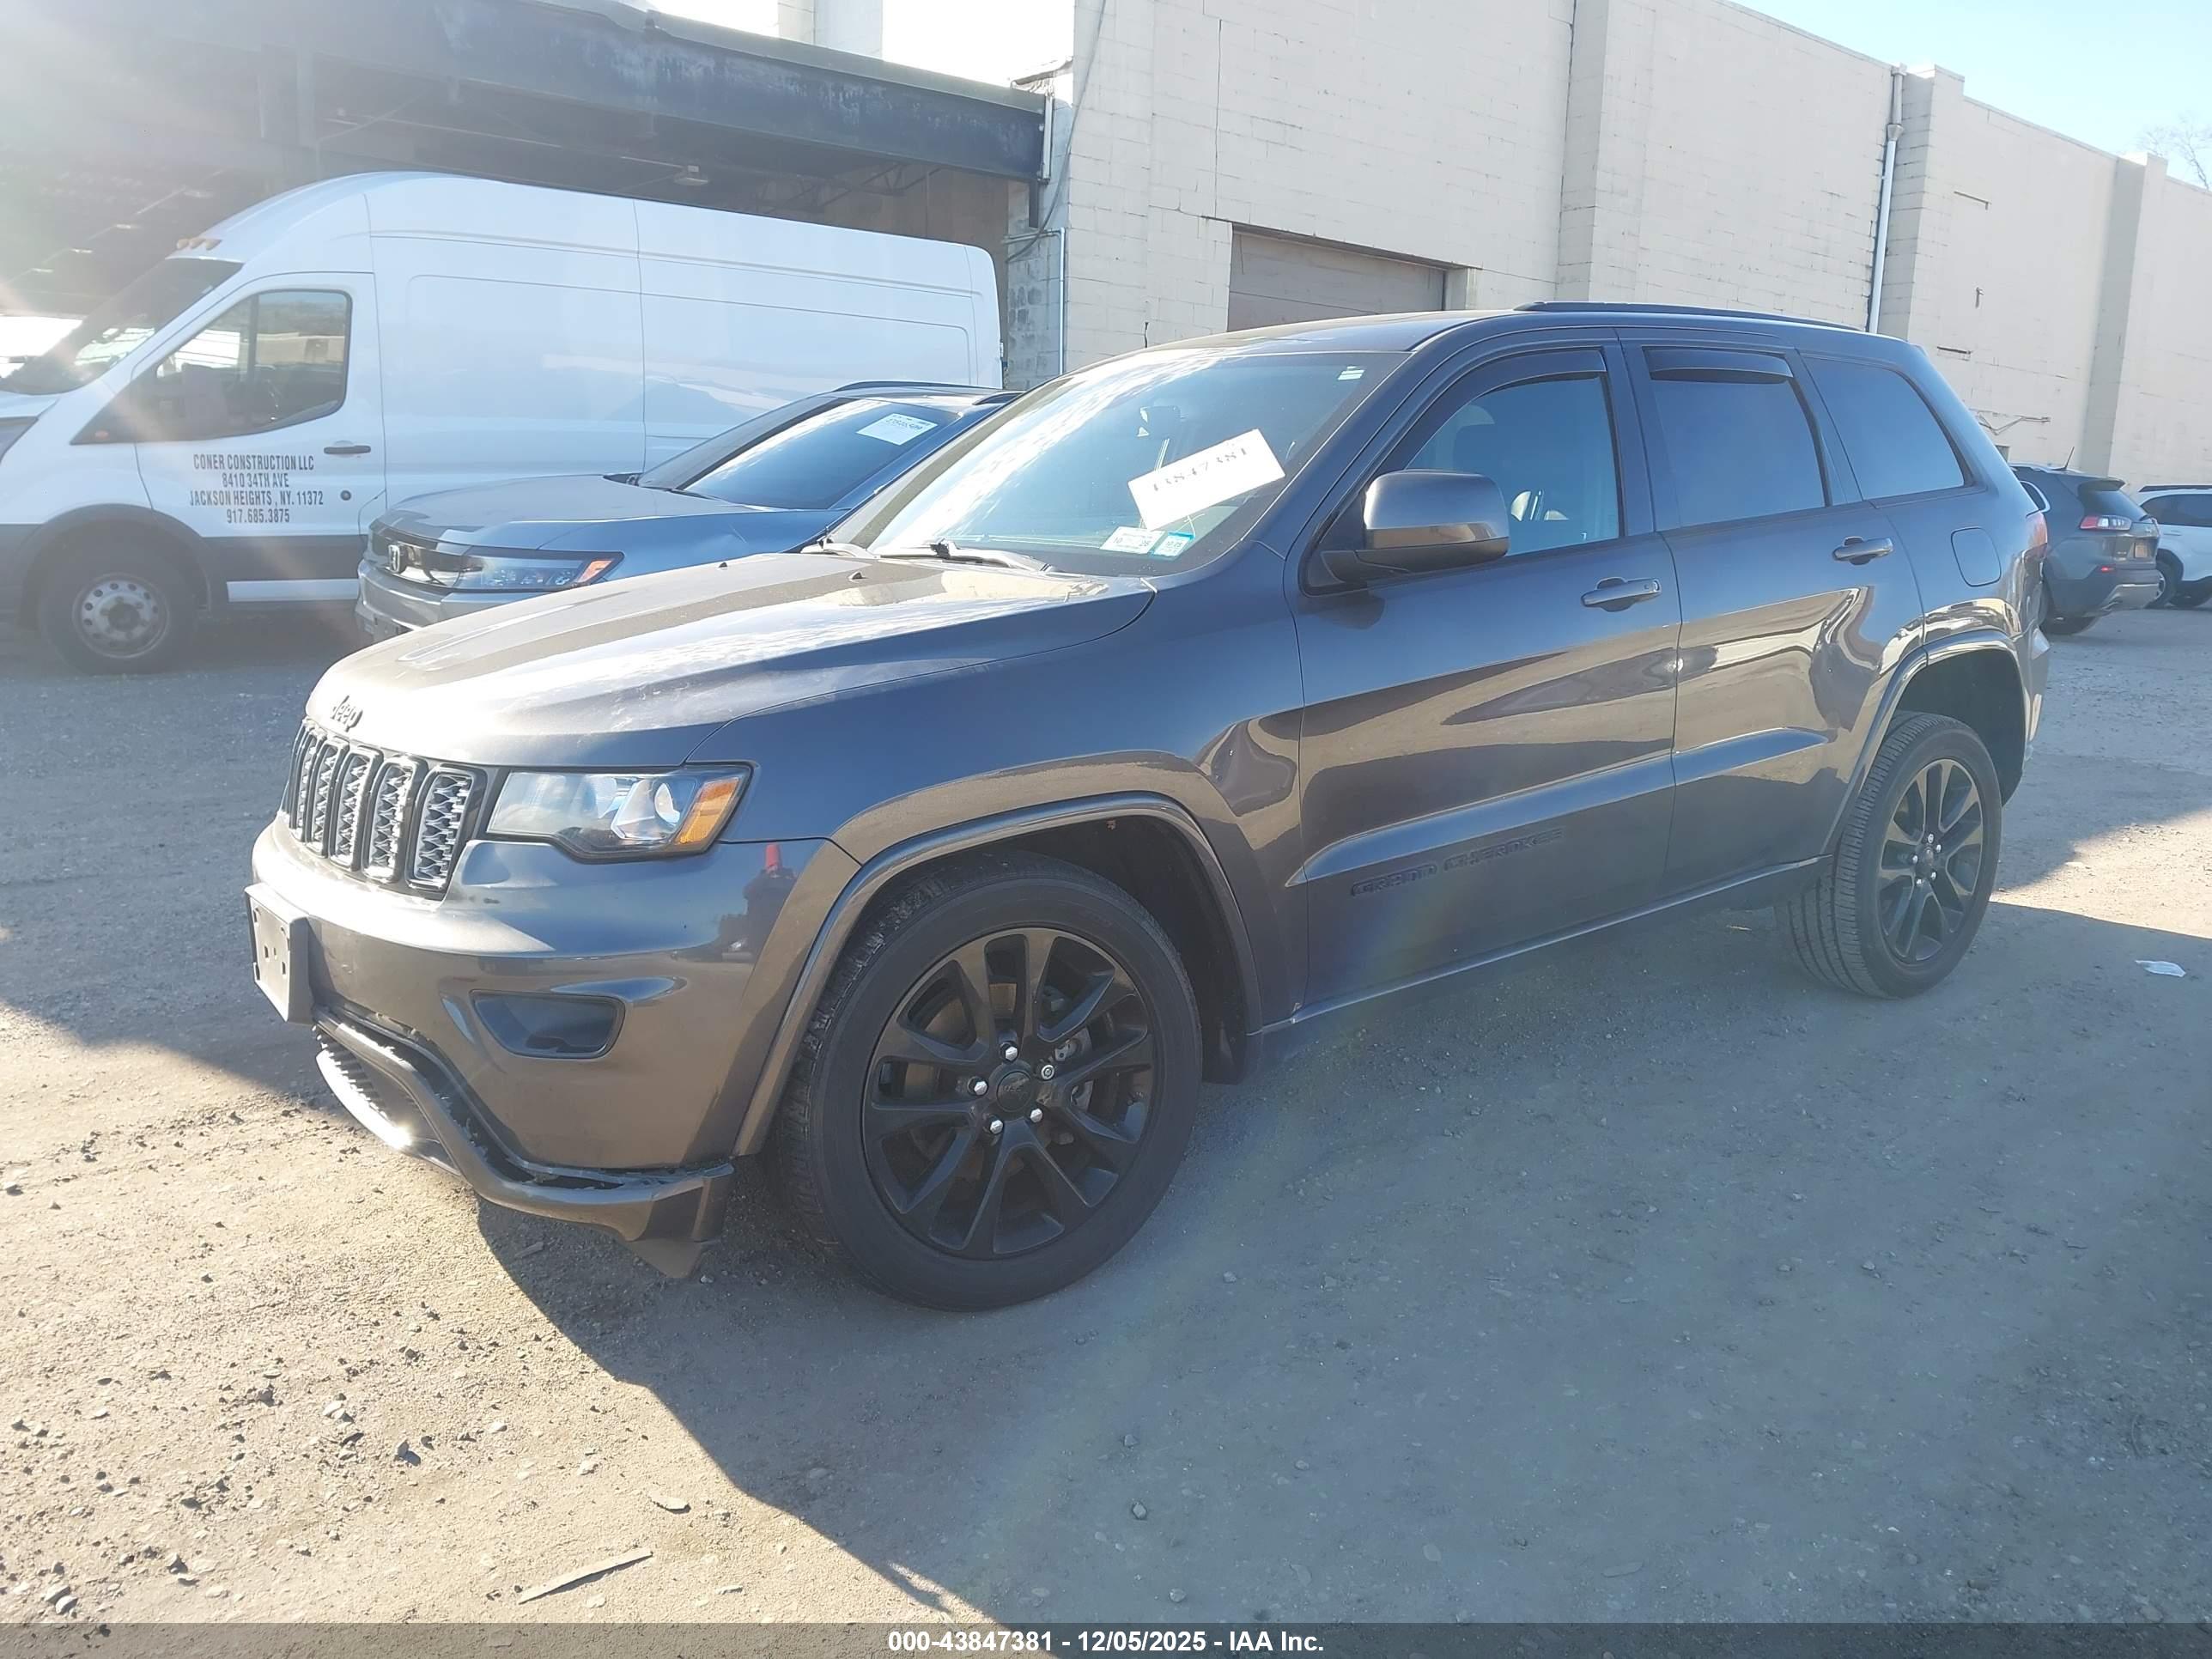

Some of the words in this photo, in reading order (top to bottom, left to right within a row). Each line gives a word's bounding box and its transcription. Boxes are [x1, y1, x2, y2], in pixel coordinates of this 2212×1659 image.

[193, 454, 225, 470] CONER
[227, 455, 296, 471] CONSTRUCTION
[298, 455, 314, 471] LLC
[222, 473, 245, 488] 8410
[246, 473, 270, 488] 34TH
[272, 473, 289, 488] AVE
[191, 491, 231, 506] JACKSON
[234, 491, 272, 506] HEIGHTS
[280, 491, 295, 506] NY.
[296, 491, 323, 505] 11372
[227, 508, 289, 523] 917.685.3875
[330, 695, 363, 732] Jeep
[1350, 864, 1437, 896] GRAND
[1443, 828, 1565, 871] CHEROKEE
